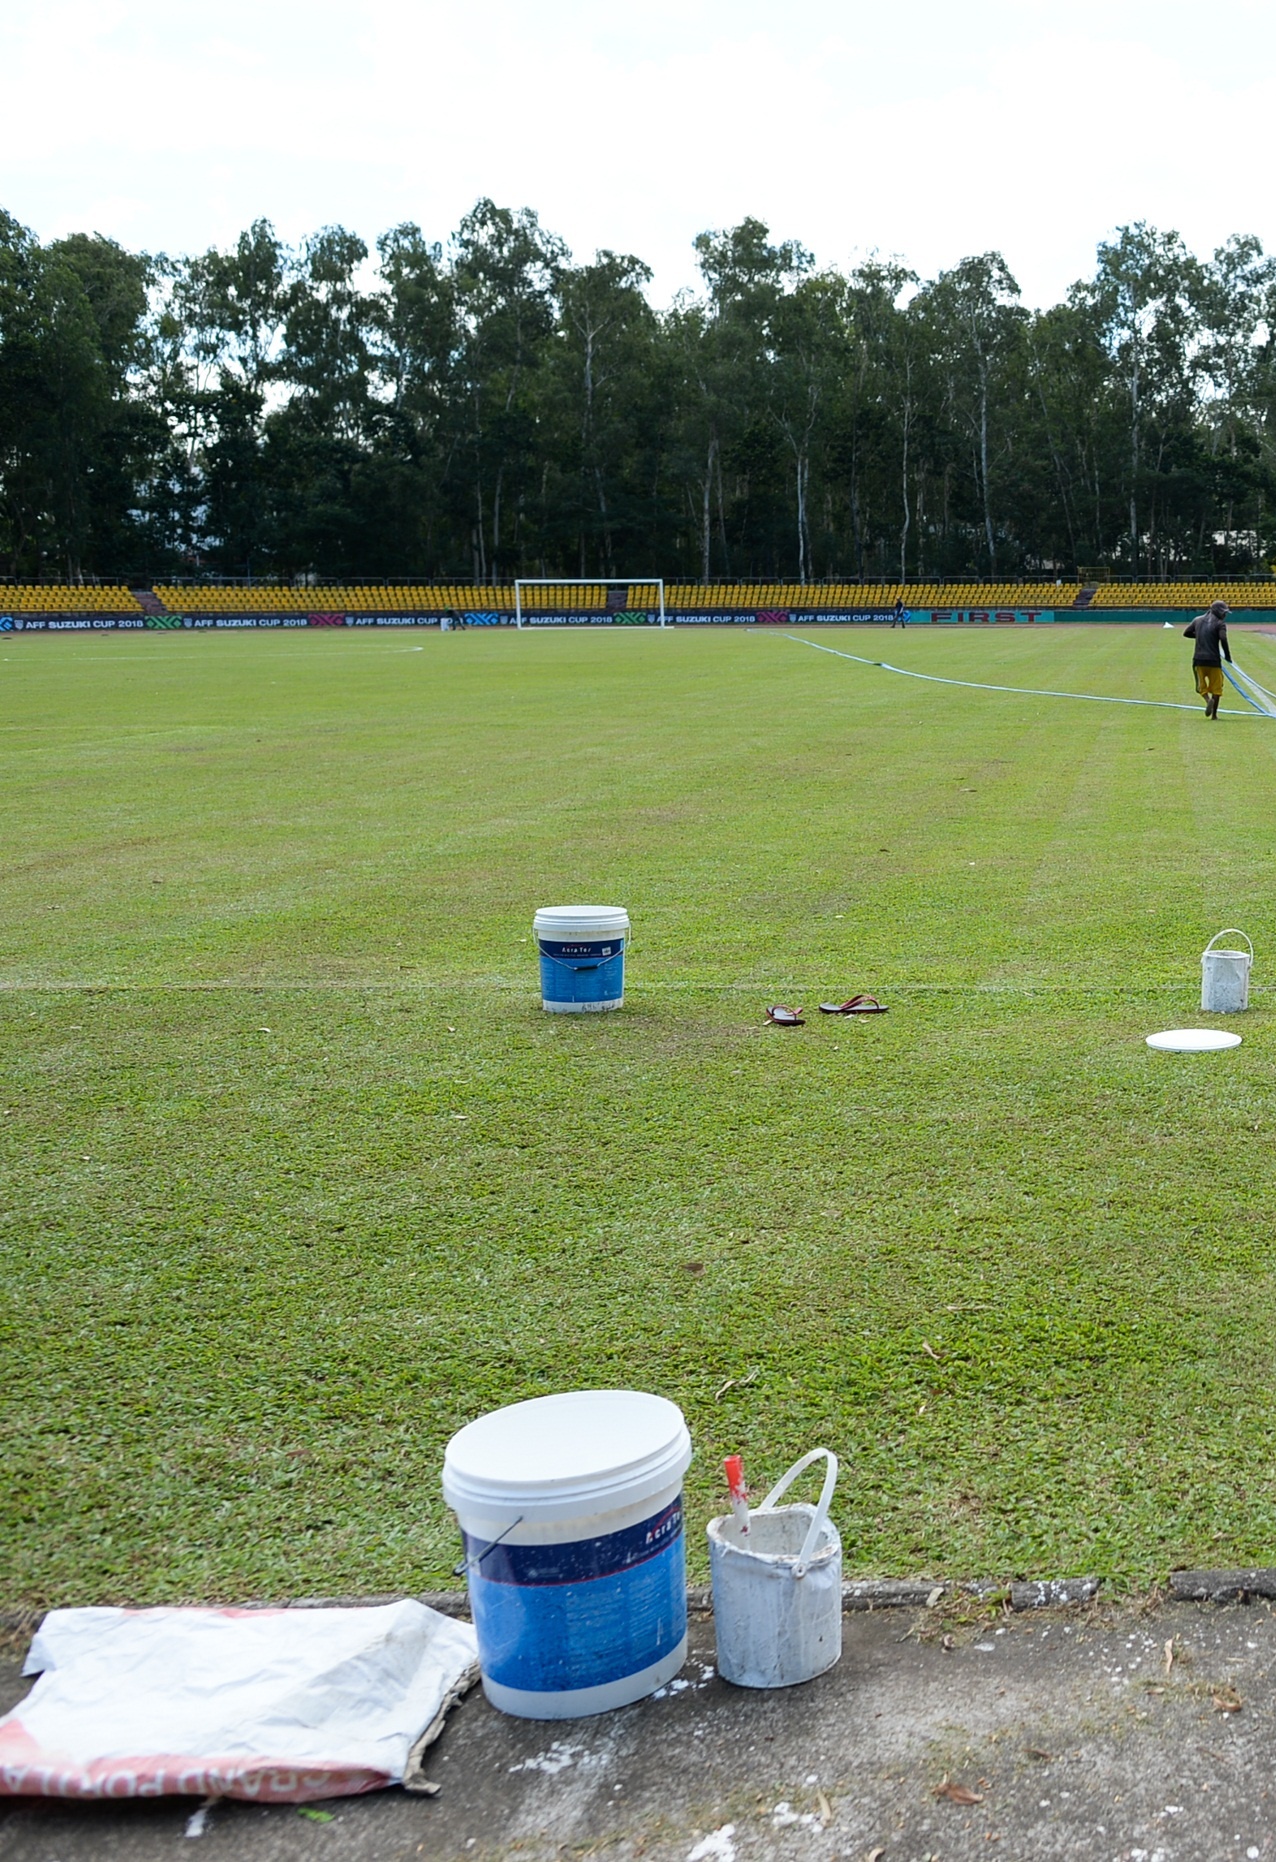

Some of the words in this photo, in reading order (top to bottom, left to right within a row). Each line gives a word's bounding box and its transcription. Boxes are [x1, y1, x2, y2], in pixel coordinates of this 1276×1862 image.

[355, 617, 374, 625] AFF
[376, 617, 415, 625] SUZUKI
[529, 616, 566, 624] SUZUKI
[676, 615, 711, 623] SUZUKI
[816, 614, 851, 622] SUZUKI
[931, 612, 1042, 622] FIRST
[25, 621, 46, 629] AFF
[48, 620, 91, 628] SUZUKI
[93, 620, 115, 628] CUP
[118, 620, 144, 628] 2018
[194, 619, 214, 627] AFF
[216, 619, 257, 627] SUZUKI
[282, 618, 308, 626] 2018
